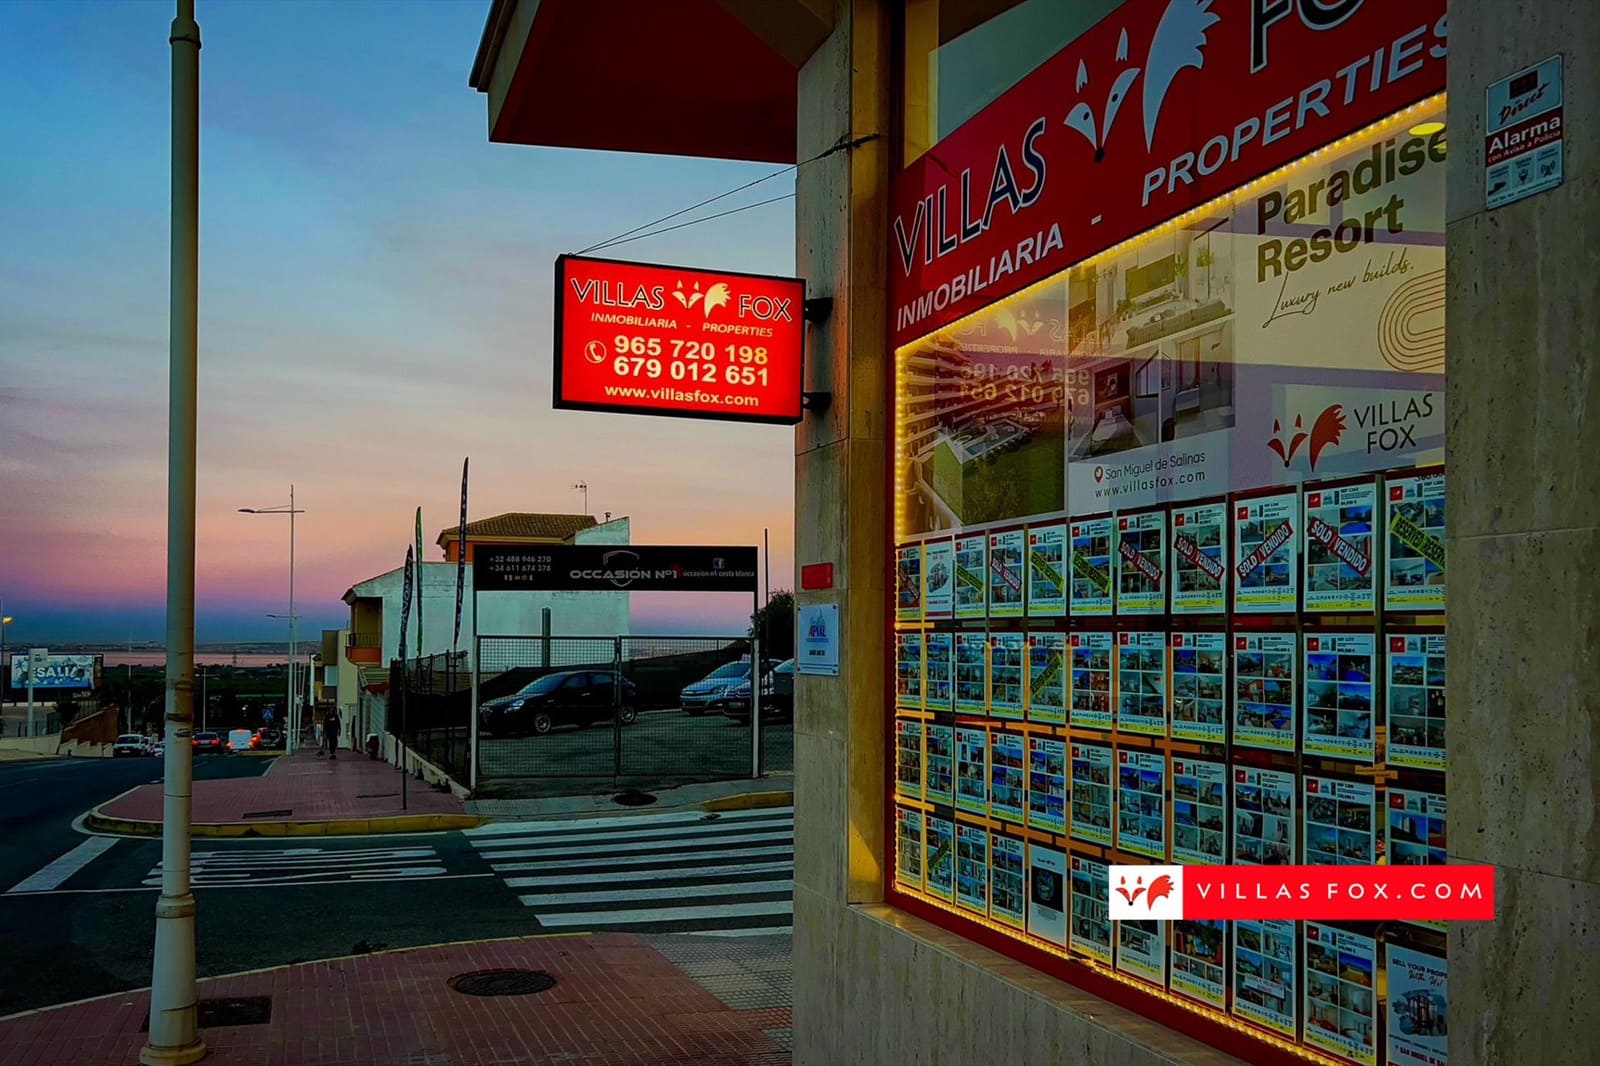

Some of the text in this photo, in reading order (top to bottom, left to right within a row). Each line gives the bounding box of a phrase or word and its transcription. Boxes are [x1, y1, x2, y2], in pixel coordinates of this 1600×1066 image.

[1489, 116, 1561, 154] Alarma
[1487, 153, 1502, 164] con
[1503, 144, 1525, 159] Aviso
[893, 116, 1047, 276] VILLAS
[1257, 126, 1447, 235] Paradise
[1257, 193, 1405, 283] Resort
[896, 223, 1064, 331] INMOBILIARIA
[571, 278, 792, 321] VILLAS FOX
[1262, 271, 1322, 328] Luxury
[1327, 277, 1357, 296] new
[591, 312, 678, 329] INMOBILIARIA
[702, 322, 774, 338] PROPERTIES
[614, 335, 768, 365] 965 720 198
[613, 357, 768, 387] 679 012 651
[604, 384, 759, 407] www.villasfox.com
[1354, 393, 1433, 428] VILLAS
[1367, 424, 1416, 454] FOX
[1105, 451, 1206, 481] San Miguel de Salinas
[1095, 471, 1206, 498] www.villasfox.com
[1176, 536, 1194, 556] SOLD
[1195, 550, 1222, 578] VENDIDO
[1238, 557, 1258, 577] SOLD
[1259, 524, 1290, 557] VENDIDO
[1311, 520, 1333, 544] SOLD
[1333, 537, 1368, 572] VENDIDO
[1407, 963, 1425, 971] YOUR
